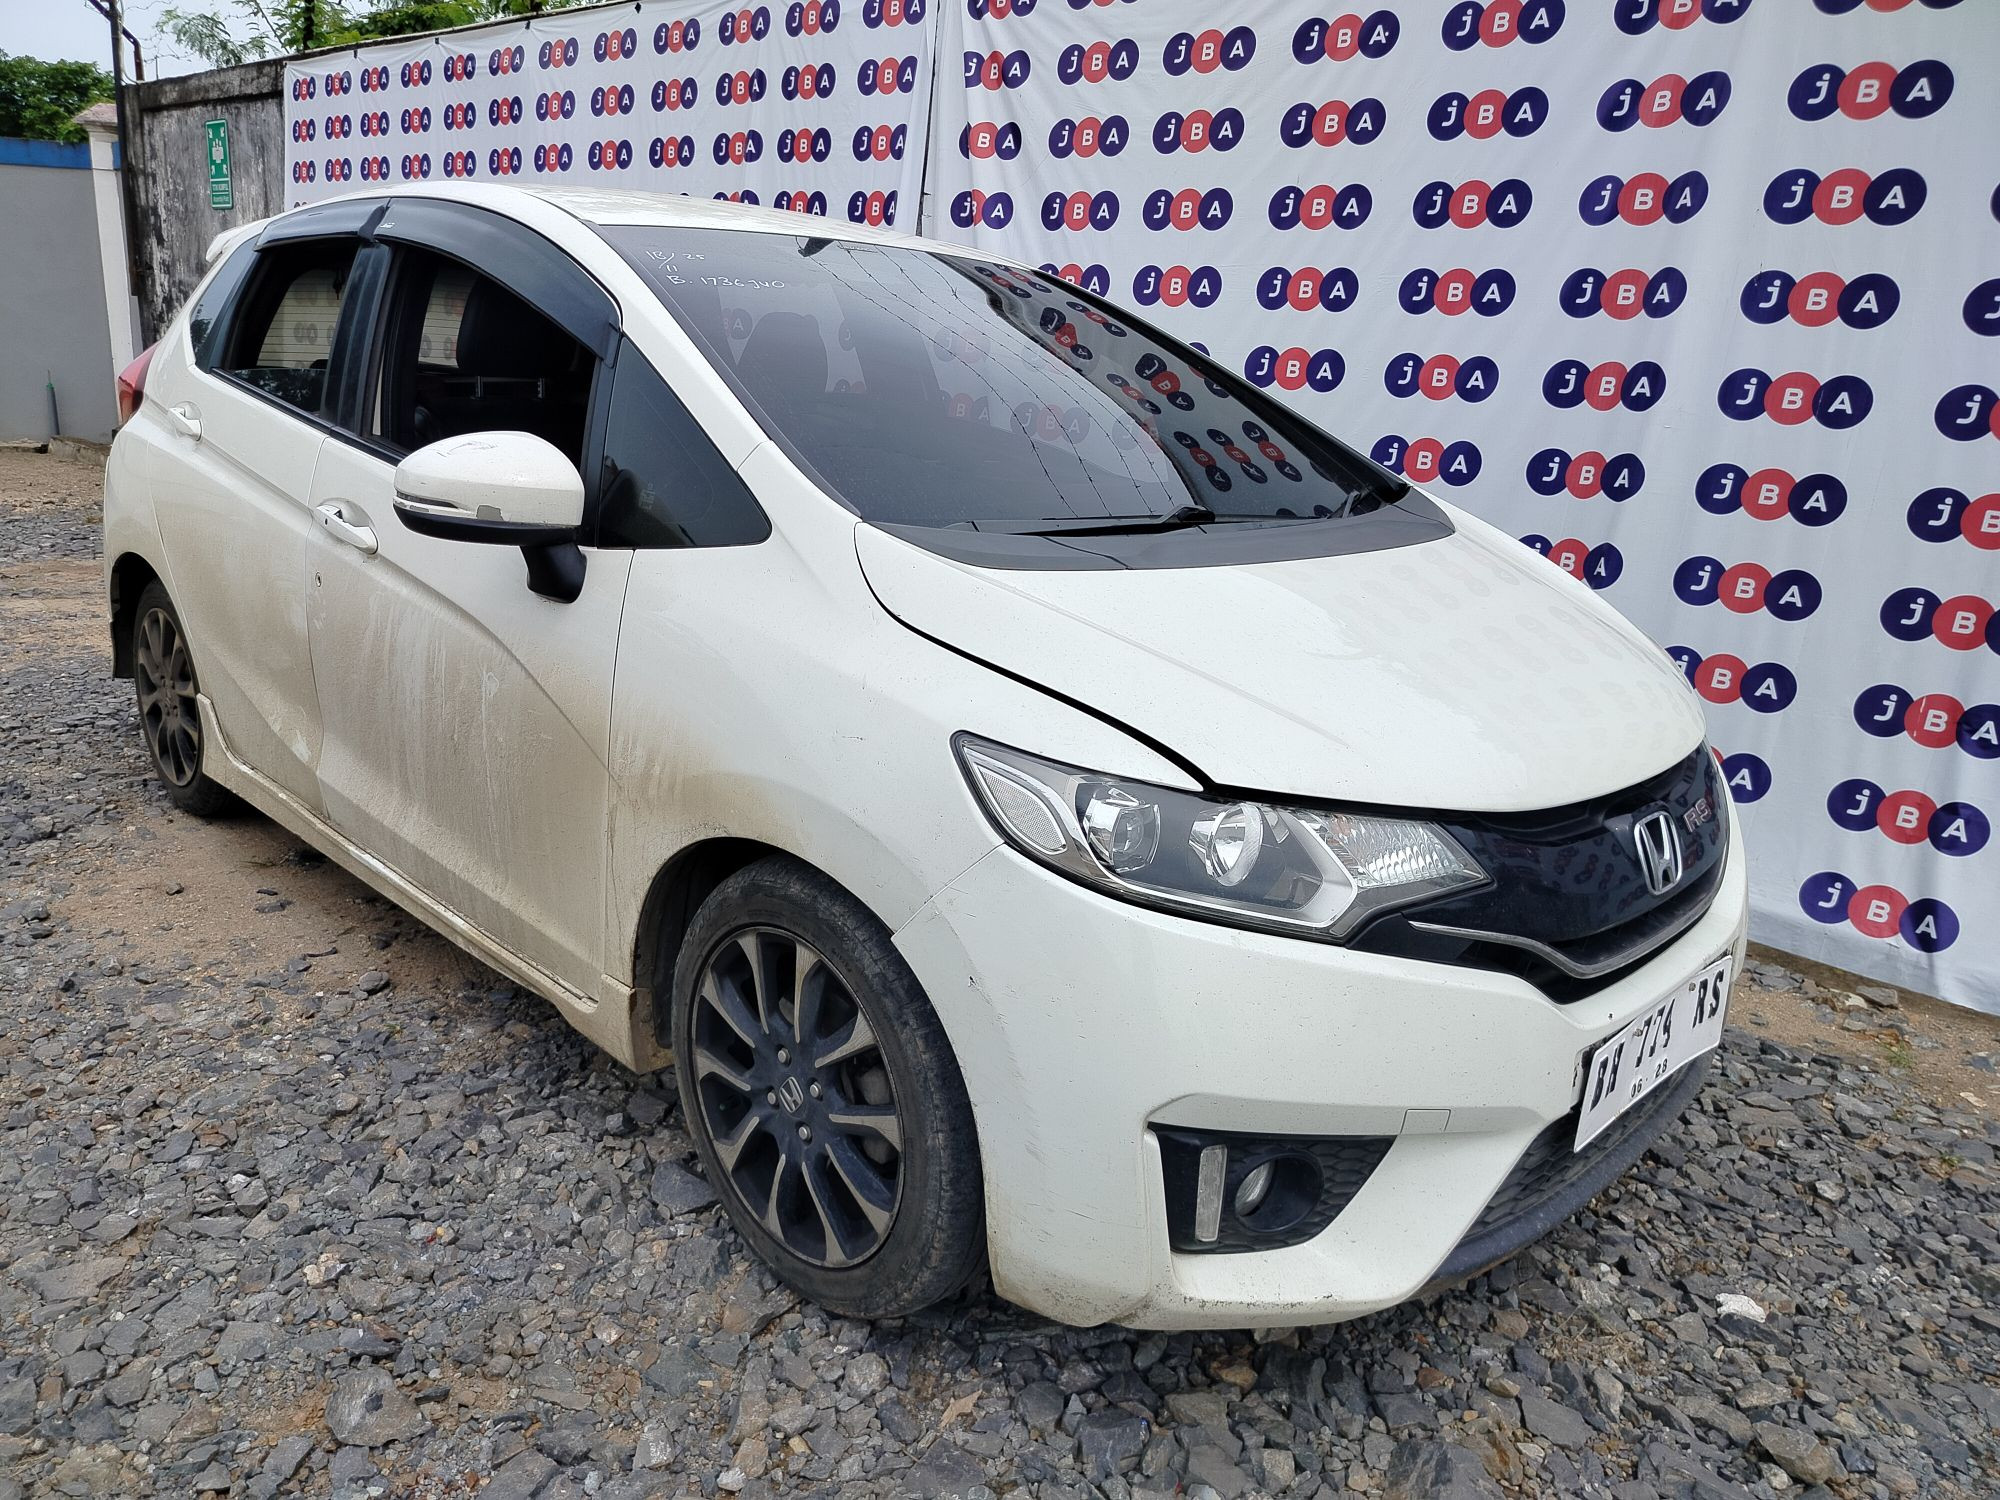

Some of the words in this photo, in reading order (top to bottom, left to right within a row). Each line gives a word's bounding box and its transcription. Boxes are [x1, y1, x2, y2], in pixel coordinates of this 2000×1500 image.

[1928, 498, 2000, 534] jB
[1683, 798, 1712, 833] RS
[1692, 969, 1725, 1028] RS
